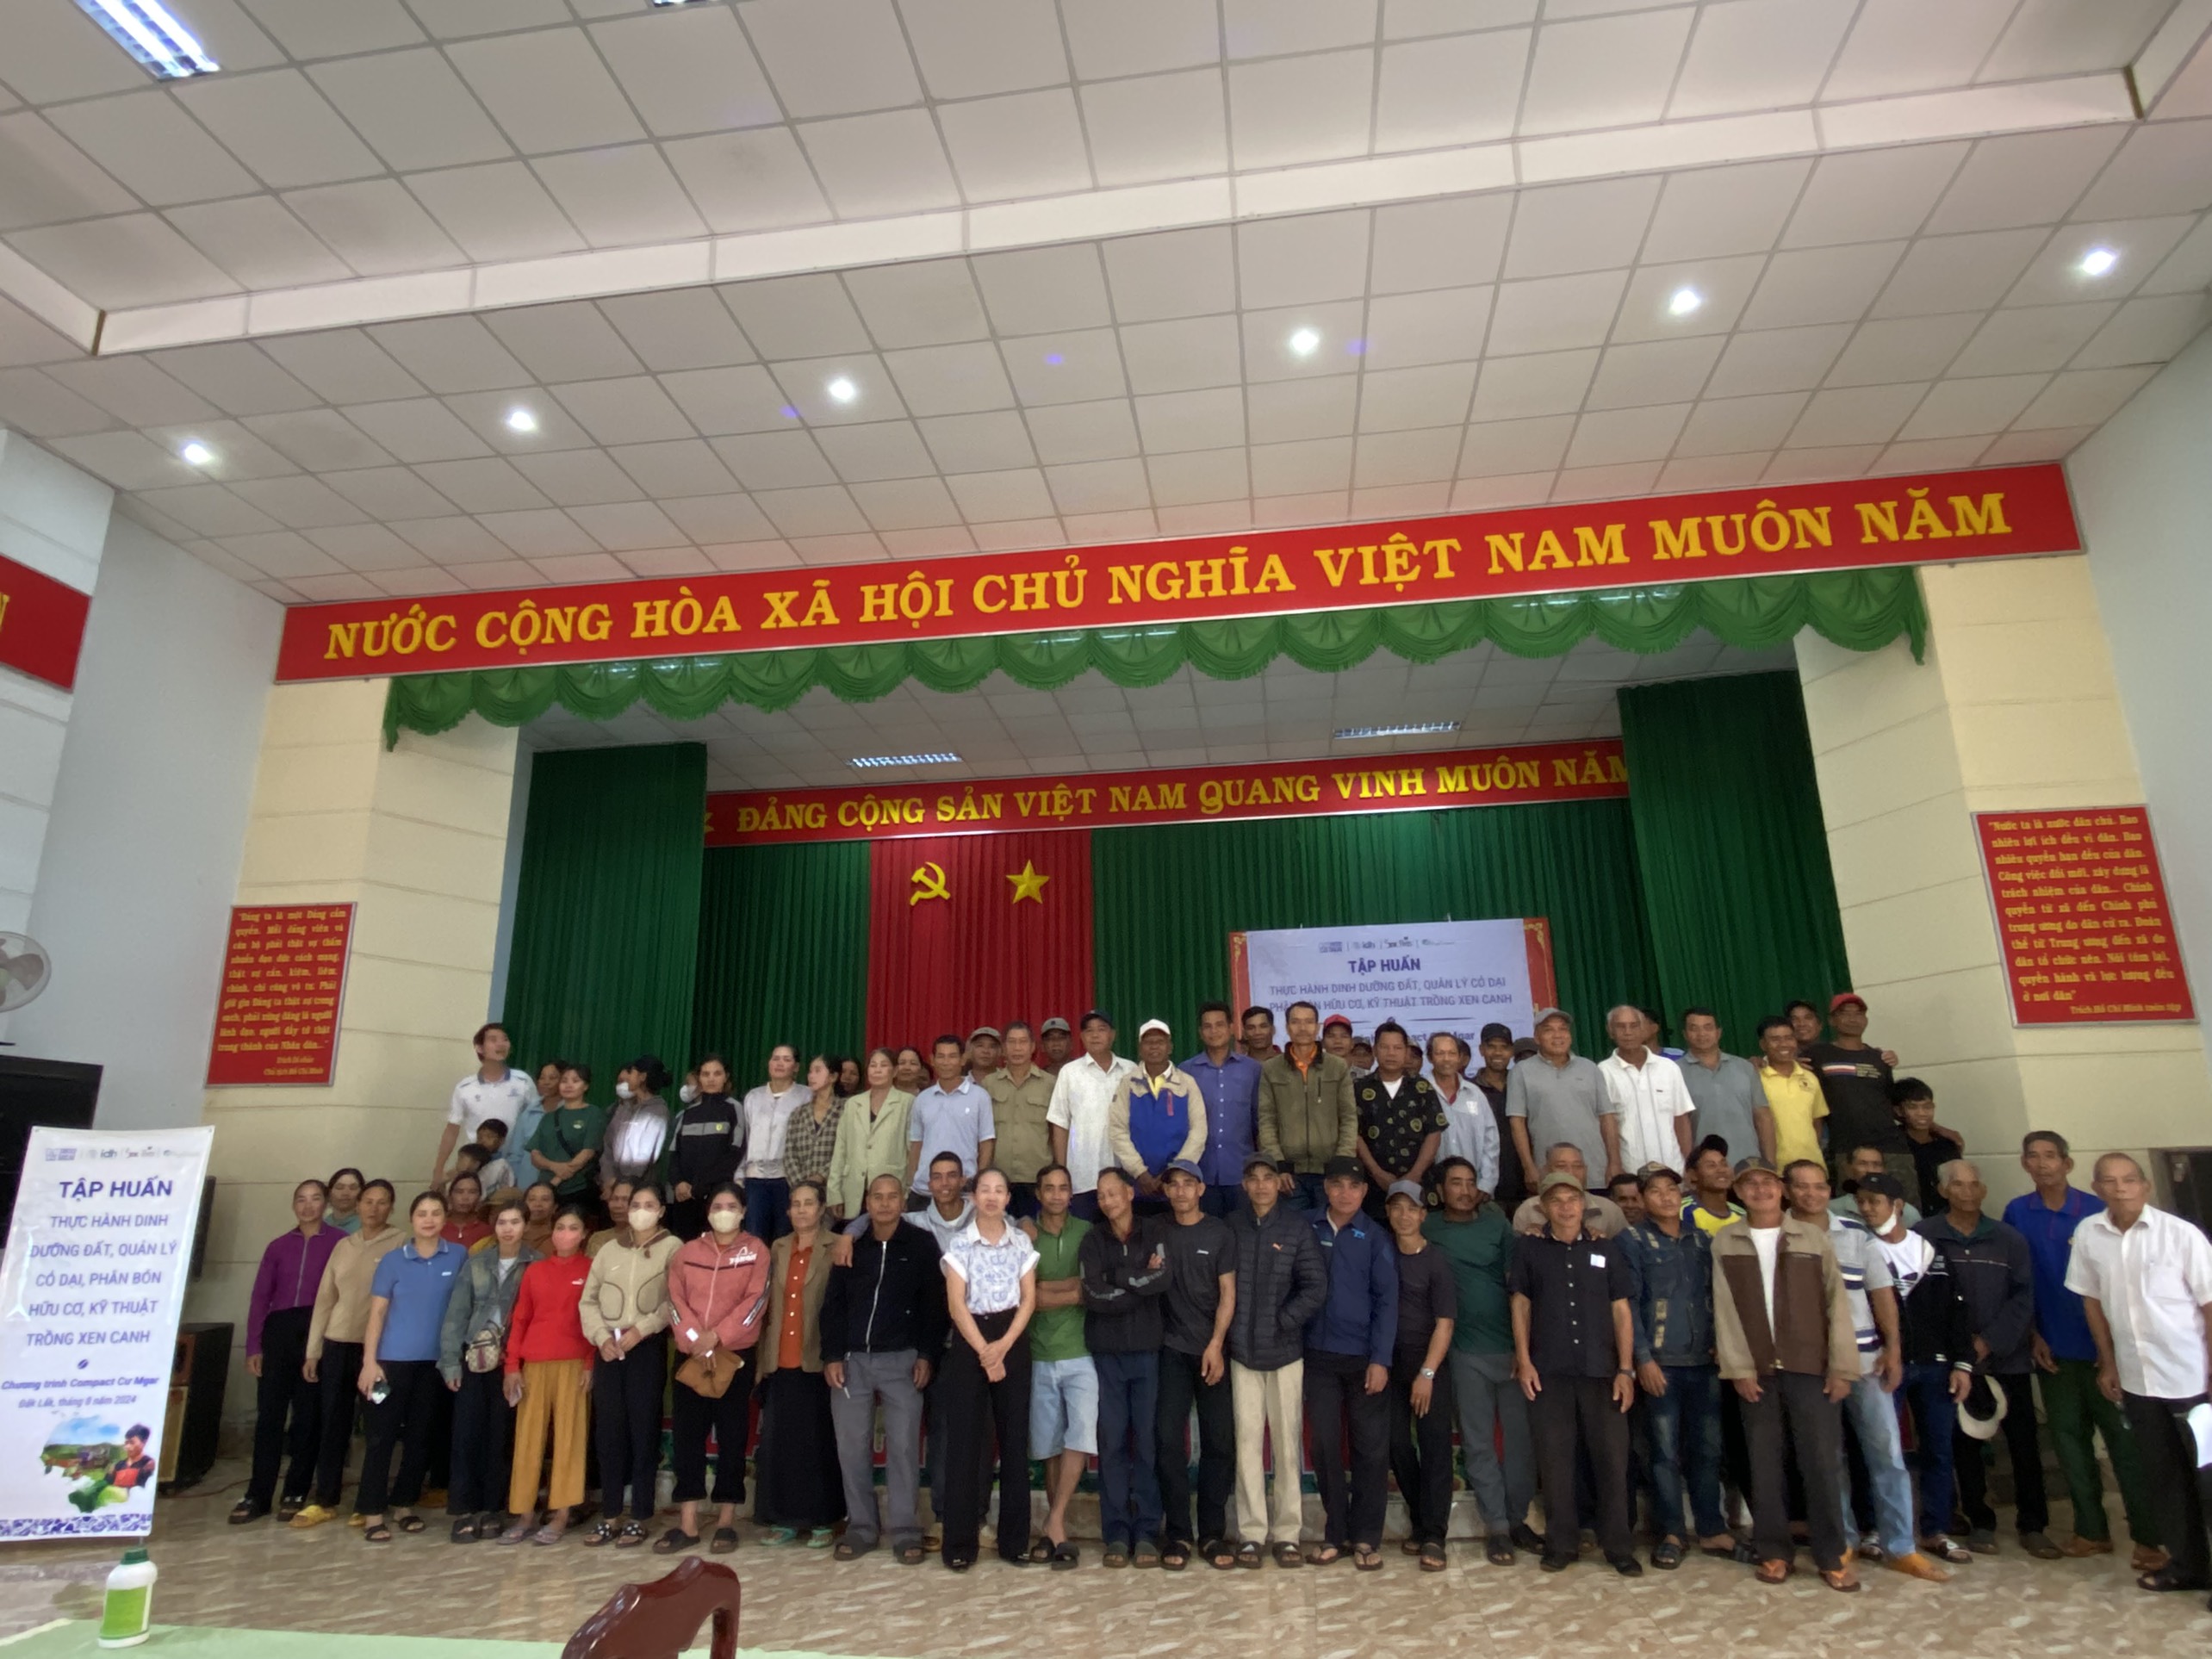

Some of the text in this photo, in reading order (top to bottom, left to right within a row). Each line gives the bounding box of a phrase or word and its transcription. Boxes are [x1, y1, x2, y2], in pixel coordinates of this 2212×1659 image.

[325, 488, 2011, 658] NƯỚC CỘNG HÒA XÃ HỘI CHỦ NGHĨA VIỆT NAM MUÔN NĂM
[736, 749, 1628, 833] ĐẢNG CỘNG SẢN VIỆT NAM QUANG VINH MUÔN NĂM
[1348, 955, 1421, 976] TẬP HUẤN
[1270, 985, 1296, 997] THỰC
[1300, 983, 1327, 994] HÀNH
[1332, 984, 1356, 993] DINH
[1359, 980, 1395, 991] DƯỠNG
[1420, 994, 1456, 1006] TRỒNG
[1458, 995, 1479, 1005] XEN
[1482, 994, 1512, 1004] CANH
[59, 1176, 173, 1202] TẬP HUẤN
[51, 1212, 169, 1231] THỰC HÀNH DINH
[30, 1240, 177, 1258] DƯỠNG ĐẤT, QUẢN LÝ
[36, 1269, 162, 1289] CỎ DẠI, PHÂN BÓN
[28, 1298, 158, 1317] HỮU CƠ, KỸ THUẬT
[27, 1330, 151, 1345] TRỒNG XEN CANH
[70, 1378, 115, 1389] Compact
[114, 1395, 136, 1405] 2024
